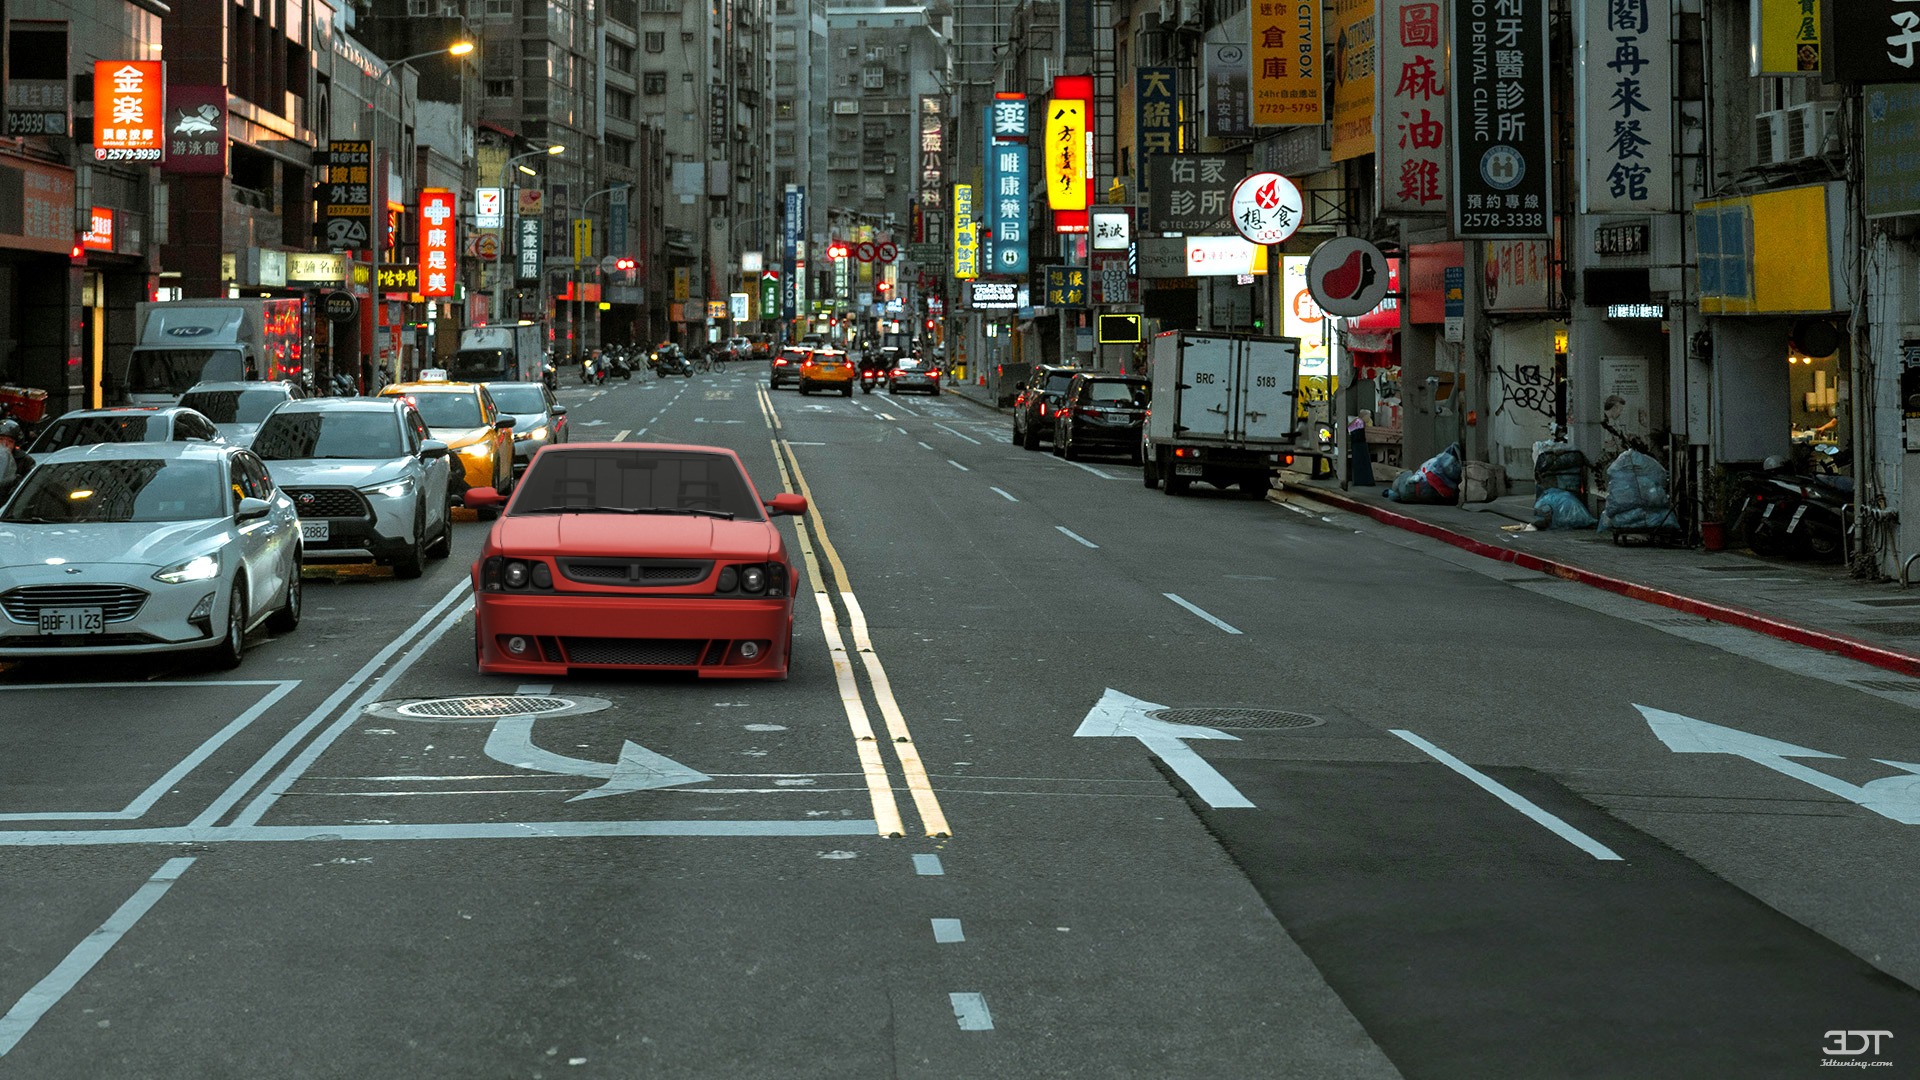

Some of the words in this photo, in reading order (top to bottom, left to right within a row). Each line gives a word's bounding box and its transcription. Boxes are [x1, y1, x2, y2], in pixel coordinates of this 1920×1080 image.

[1260, 4, 1287, 16] 迷你
[1298, 4, 1313, 79] CITYBOX
[1261, 25, 1288, 80] 倉庫
[1472, 22, 1487, 85] DENTAL
[1259, 103, 1318, 114] 7729-5795
[1394, 3, 1445, 207] 圖麻油雞
[1474, 88, 1489, 142] CLINIC
[107, 149, 160, 160] 2579-3939
[172, 141, 219, 156] 游泳館
[331, 143, 368, 153] PIZZA
[331, 166, 368, 184] 披薩
[1170, 158, 1226, 183] 佑家
[331, 185, 368, 204] 外送
[1170, 190, 1225, 216] 診所
[1467, 194, 1539, 210] 預約專線
[1464, 213, 1542, 227] 2578-3338
[522, 219, 538, 278] 英豪西服
[427, 229, 447, 292] 康是美
[786, 272, 794, 308] SONY
[1196, 373, 1214, 384] BRC
[1257, 376, 1276, 387] 5183
[41, 615, 101, 630] BBF-1123
